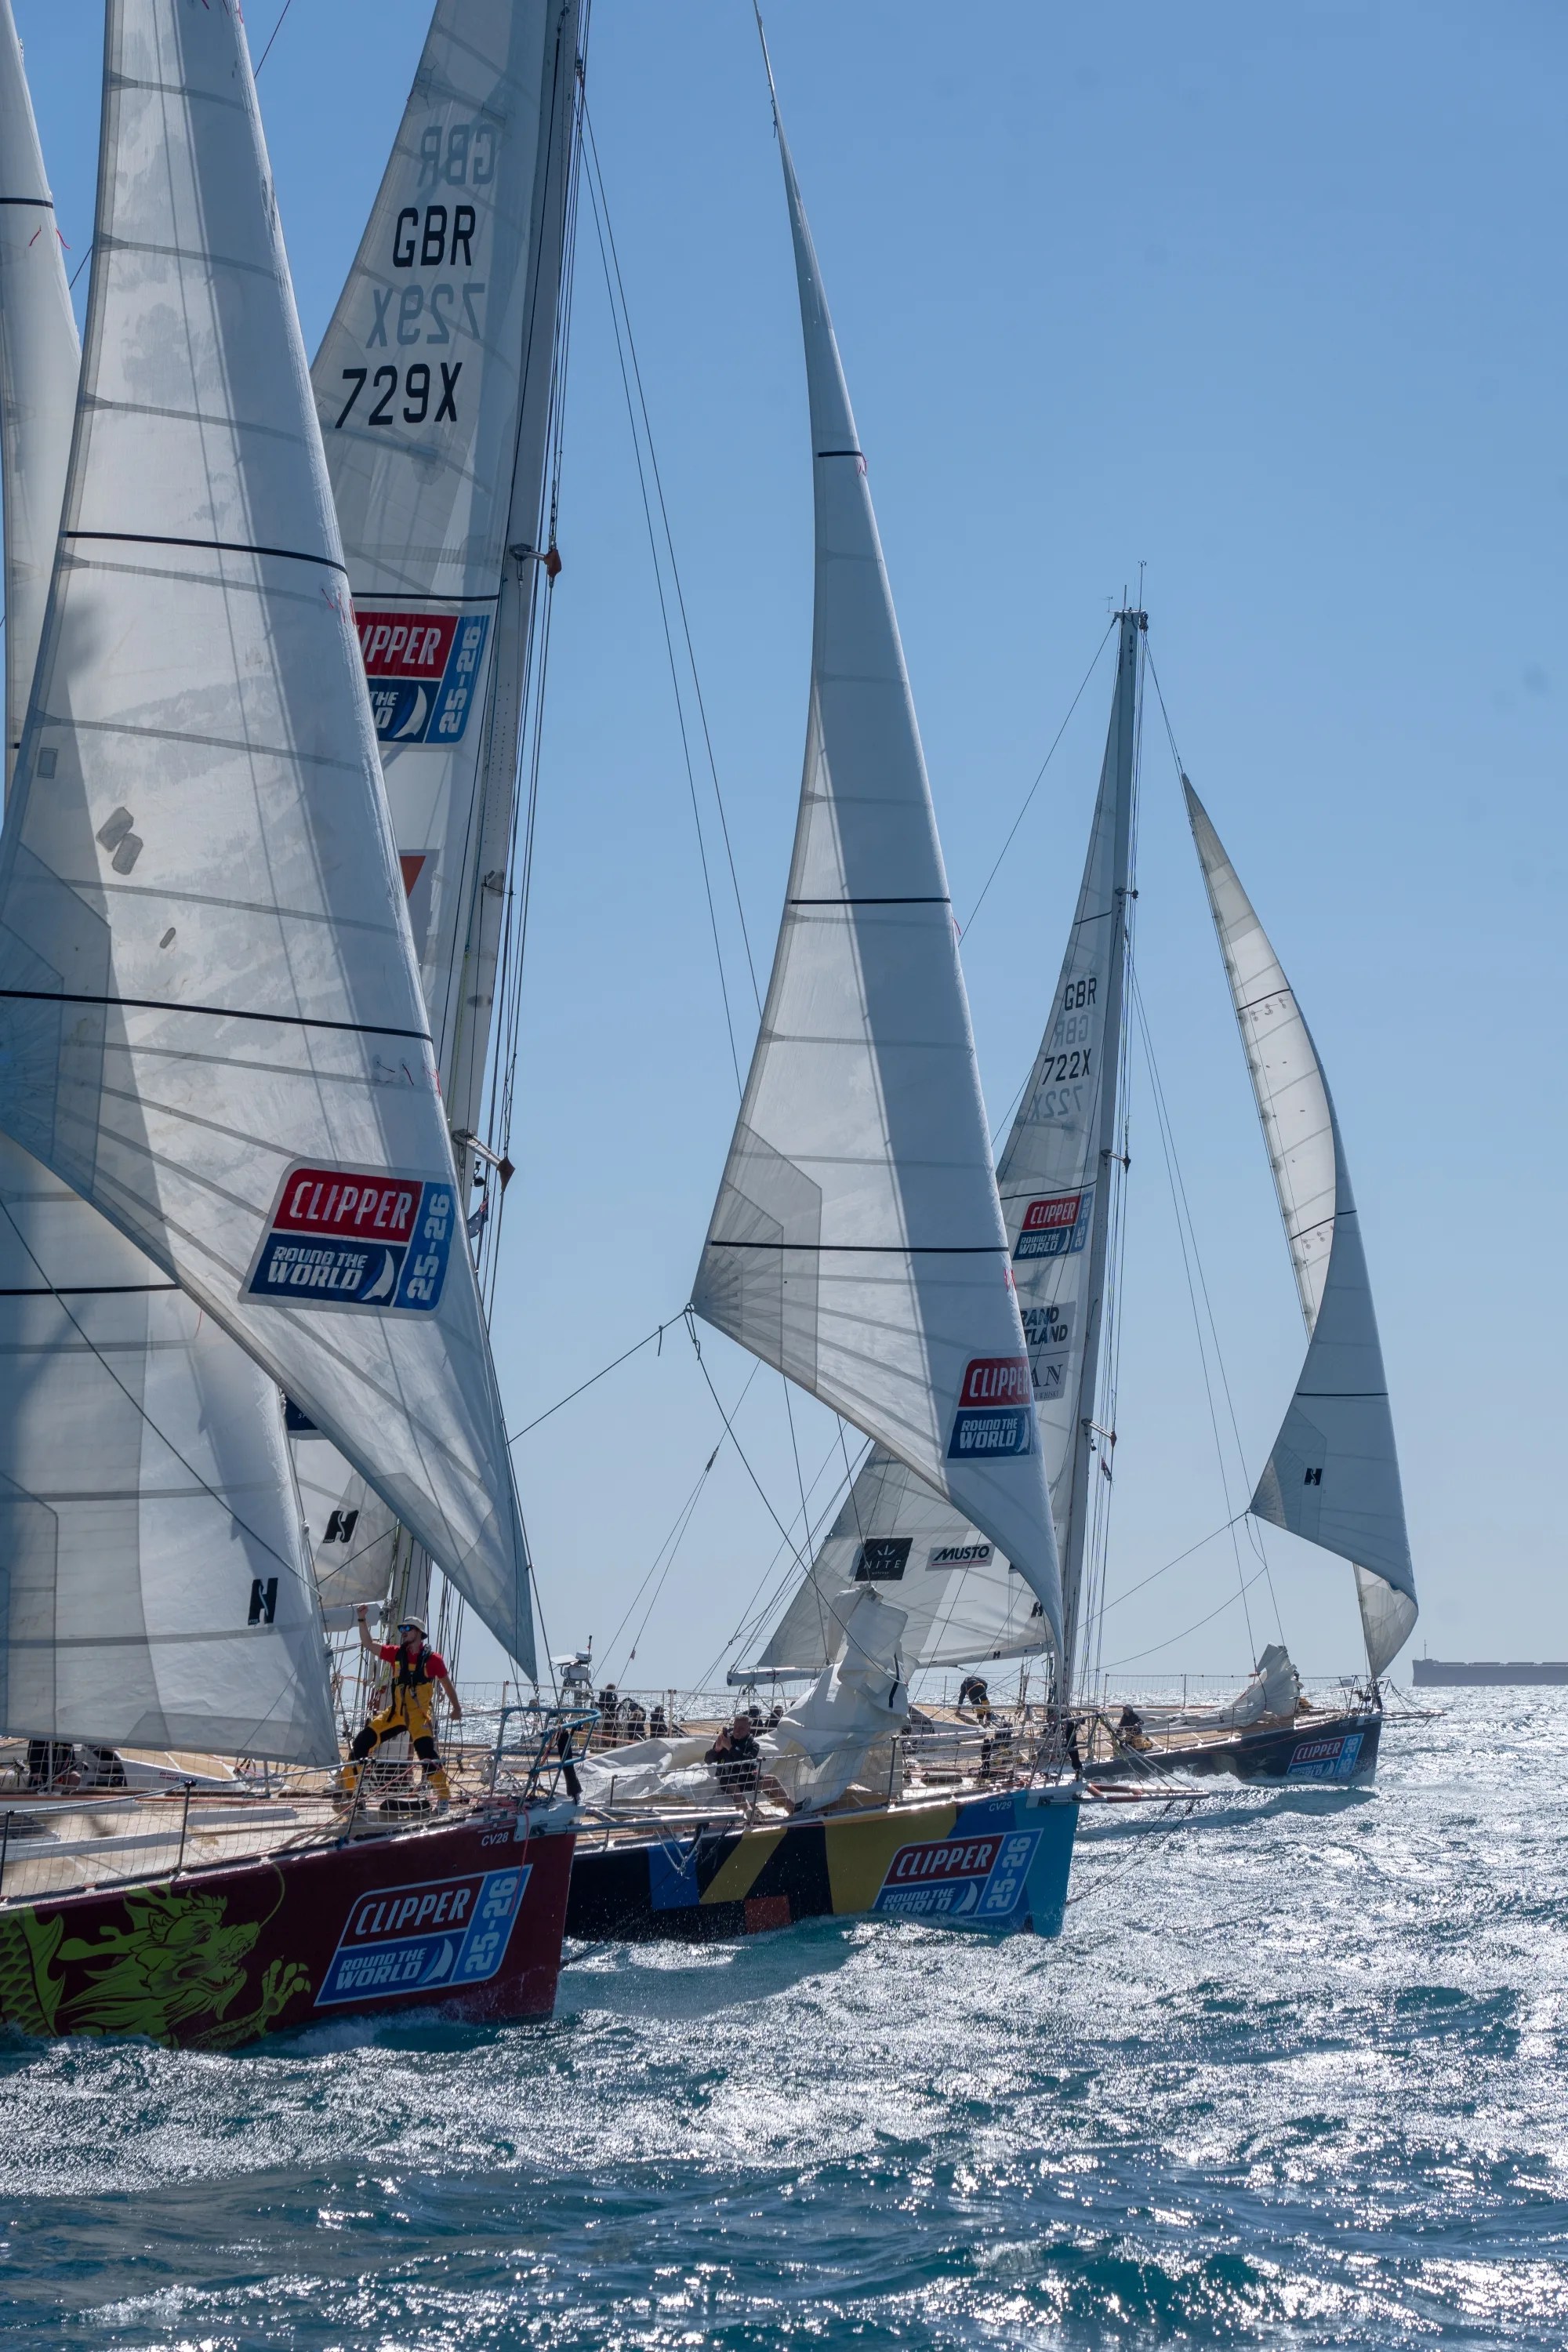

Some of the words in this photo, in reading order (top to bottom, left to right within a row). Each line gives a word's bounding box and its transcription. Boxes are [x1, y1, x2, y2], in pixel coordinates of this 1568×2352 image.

[393, 205, 476, 267] GBR
[335, 361, 463, 429] 729X
[355, 625, 441, 665] IPPER
[438, 626, 482, 734] 25-26
[1064, 977, 1098, 1011] GBR
[1042, 1048, 1092, 1085] 722X
[289, 1181, 413, 1229] CLIPPER
[1030, 1202, 1076, 1225] CLIPPER
[407, 1193, 450, 1301] 25-26
[1018, 1240, 1058, 1254] WORLD
[1021, 1235, 1047, 1244] ROUND
[1047, 1233, 1060, 1242] THE
[272, 1246, 335, 1265] ROUND
[336, 1251, 368, 1269] THE
[267, 1261, 364, 1290] WORLD
[969, 1366, 1028, 1398] CLIPPER
[960, 1429, 1017, 1449] WORLD
[961, 1419, 1001, 1432] ROUND
[1001, 1418, 1018, 1430] THE
[864, 1560, 901, 1569] NITE
[933, 1545, 989, 1561] MUSTO
[1296, 1742, 1341, 1760] CLIPPER
[989, 1801, 1012, 1813] CV29
[481, 1831, 509, 1846] CV28
[896, 1843, 993, 1877] CLIPPER
[986, 1837, 1032, 1909] 25-26
[884, 1890, 928, 1904] ROUND
[931, 1887, 956, 1898] THE
[354, 1888, 471, 1935] CLIPPER
[464, 1877, 518, 1973] 25-26
[340, 1951, 394, 1972] ROUND
[396, 1947, 427, 1964] THE
[336, 1963, 424, 1990] WORLD
